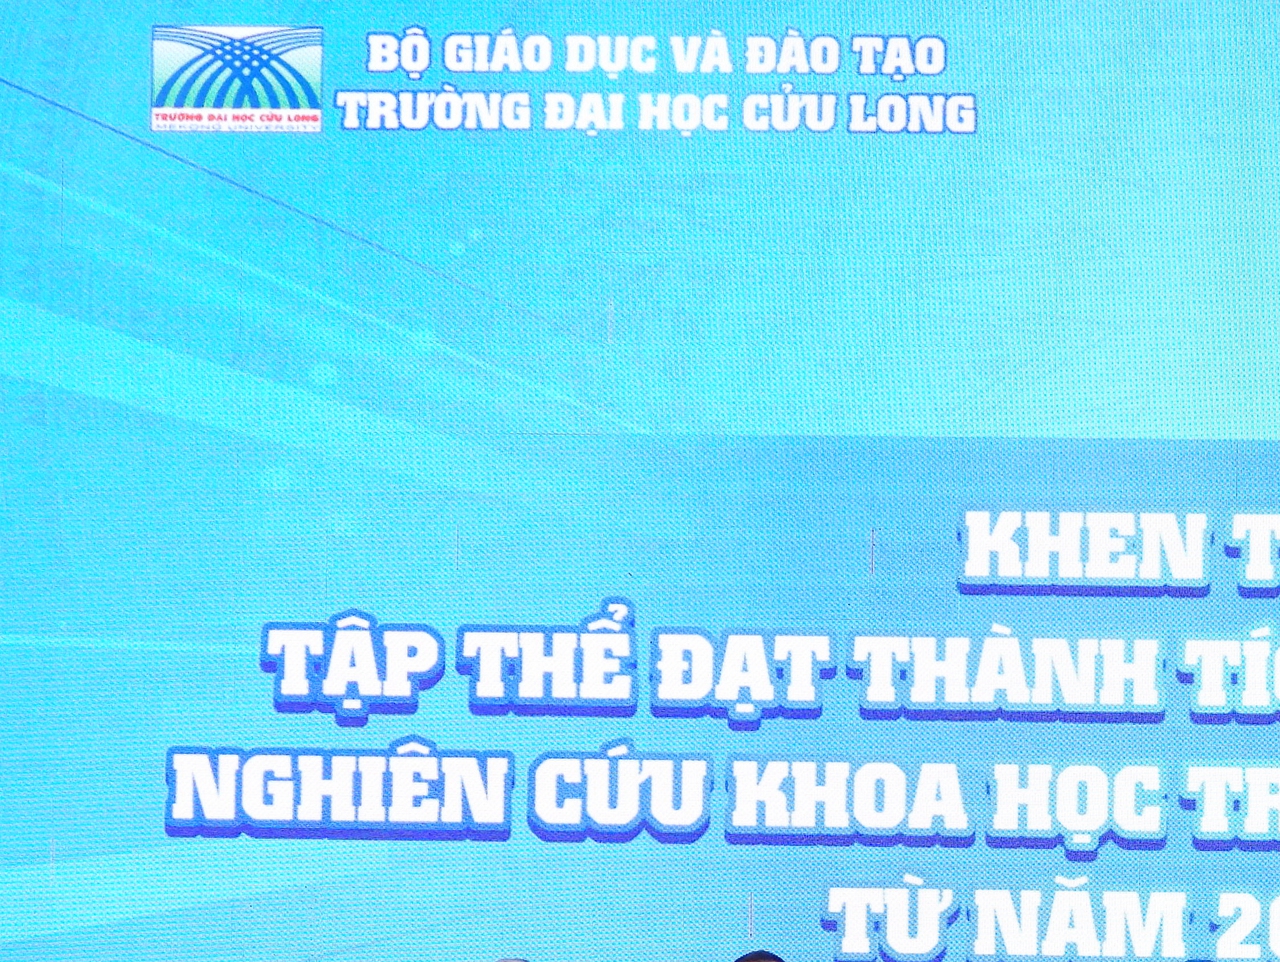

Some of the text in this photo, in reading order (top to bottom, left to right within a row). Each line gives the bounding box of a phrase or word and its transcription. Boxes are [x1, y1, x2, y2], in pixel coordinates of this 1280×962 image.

[370, 28, 944, 80] BỘ GIÁO DỤC VÀ ĐÀO TẠO
[337, 83, 975, 137] TRƯỜNG ĐẠI HỌC CỬU LONG
[964, 511, 1207, 580] KHEN
[268, 616, 438, 709] TẬP
[463, 604, 631, 699] THỂ
[657, 634, 830, 713] ĐẠT
[854, 622, 1159, 705] THÀNH
[172, 741, 508, 824] NGHIÊN
[535, 744, 707, 826] CỨU
[732, 761, 968, 830] KHOA
[993, 764, 1161, 844] HỌC
[828, 874, 953, 954] TỪ
[974, 875, 1186, 958] NĂM
